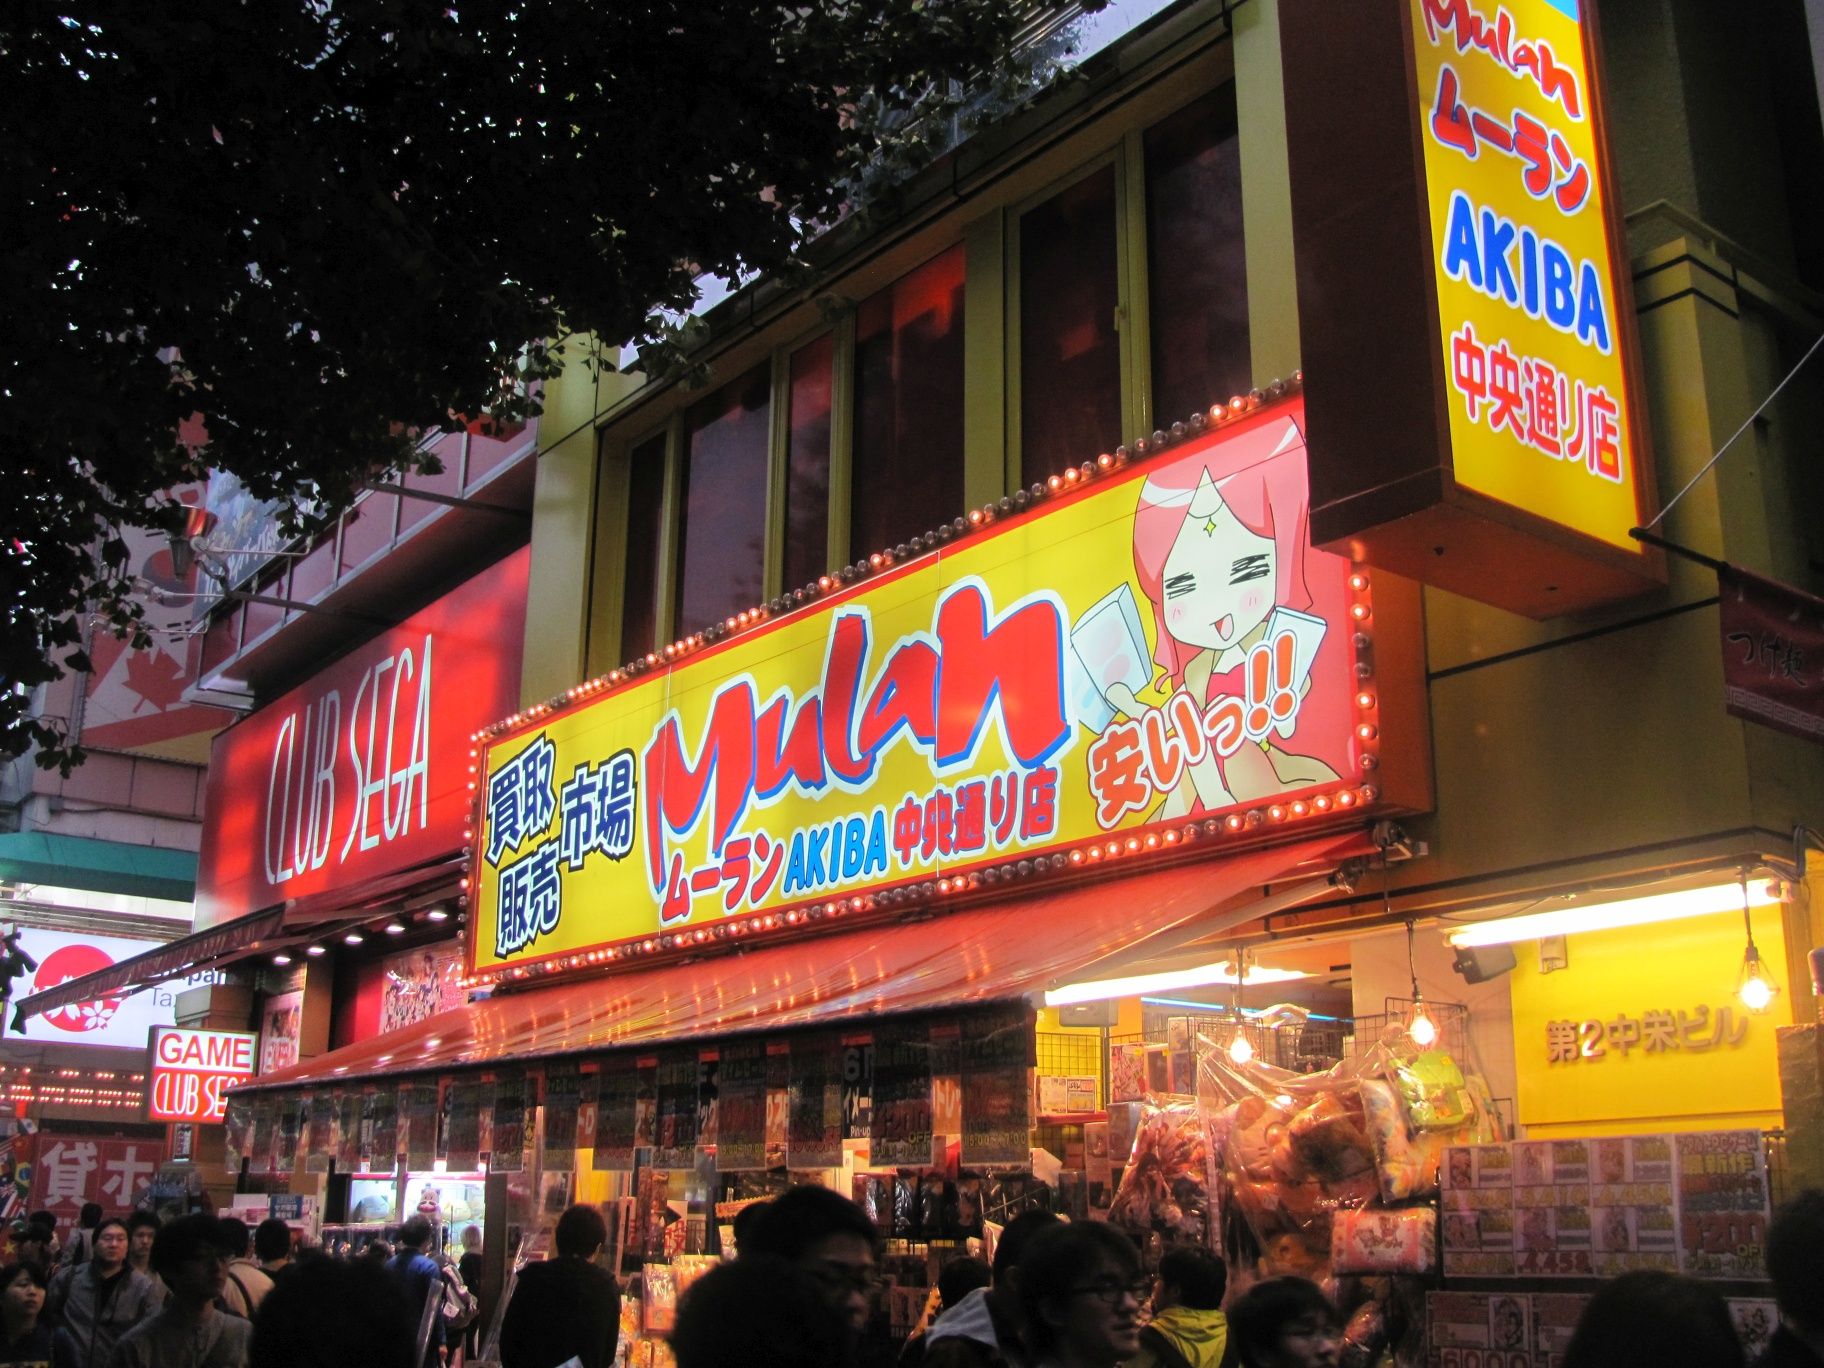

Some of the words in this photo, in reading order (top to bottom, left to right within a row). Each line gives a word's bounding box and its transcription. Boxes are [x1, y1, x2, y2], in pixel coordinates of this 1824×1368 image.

[1423, 0, 1584, 119] Mulan
[1431, 67, 1589, 214] ムーラン
[1443, 192, 1611, 353] AKIBA
[1452, 323, 1622, 482] 中央通り店
[265, 690, 340, 884] CLUB
[341, 634, 432, 864] SEGA
[486, 733, 557, 868] 買取
[641, 578, 1076, 898] Mulan
[560, 749, 637, 871] 市場
[660, 835, 785, 924] ムーラン
[785, 808, 887, 894] AKIBA
[892, 764, 1060, 873] 中央通り店
[495, 838, 561, 958] 販売
[153, 1073, 200, 1116] CLUB
[203, 1075, 247, 1117] SE
[159, 1033, 252, 1068] GAME
[1546, 1004, 1749, 1062] 第2中栄ビル
